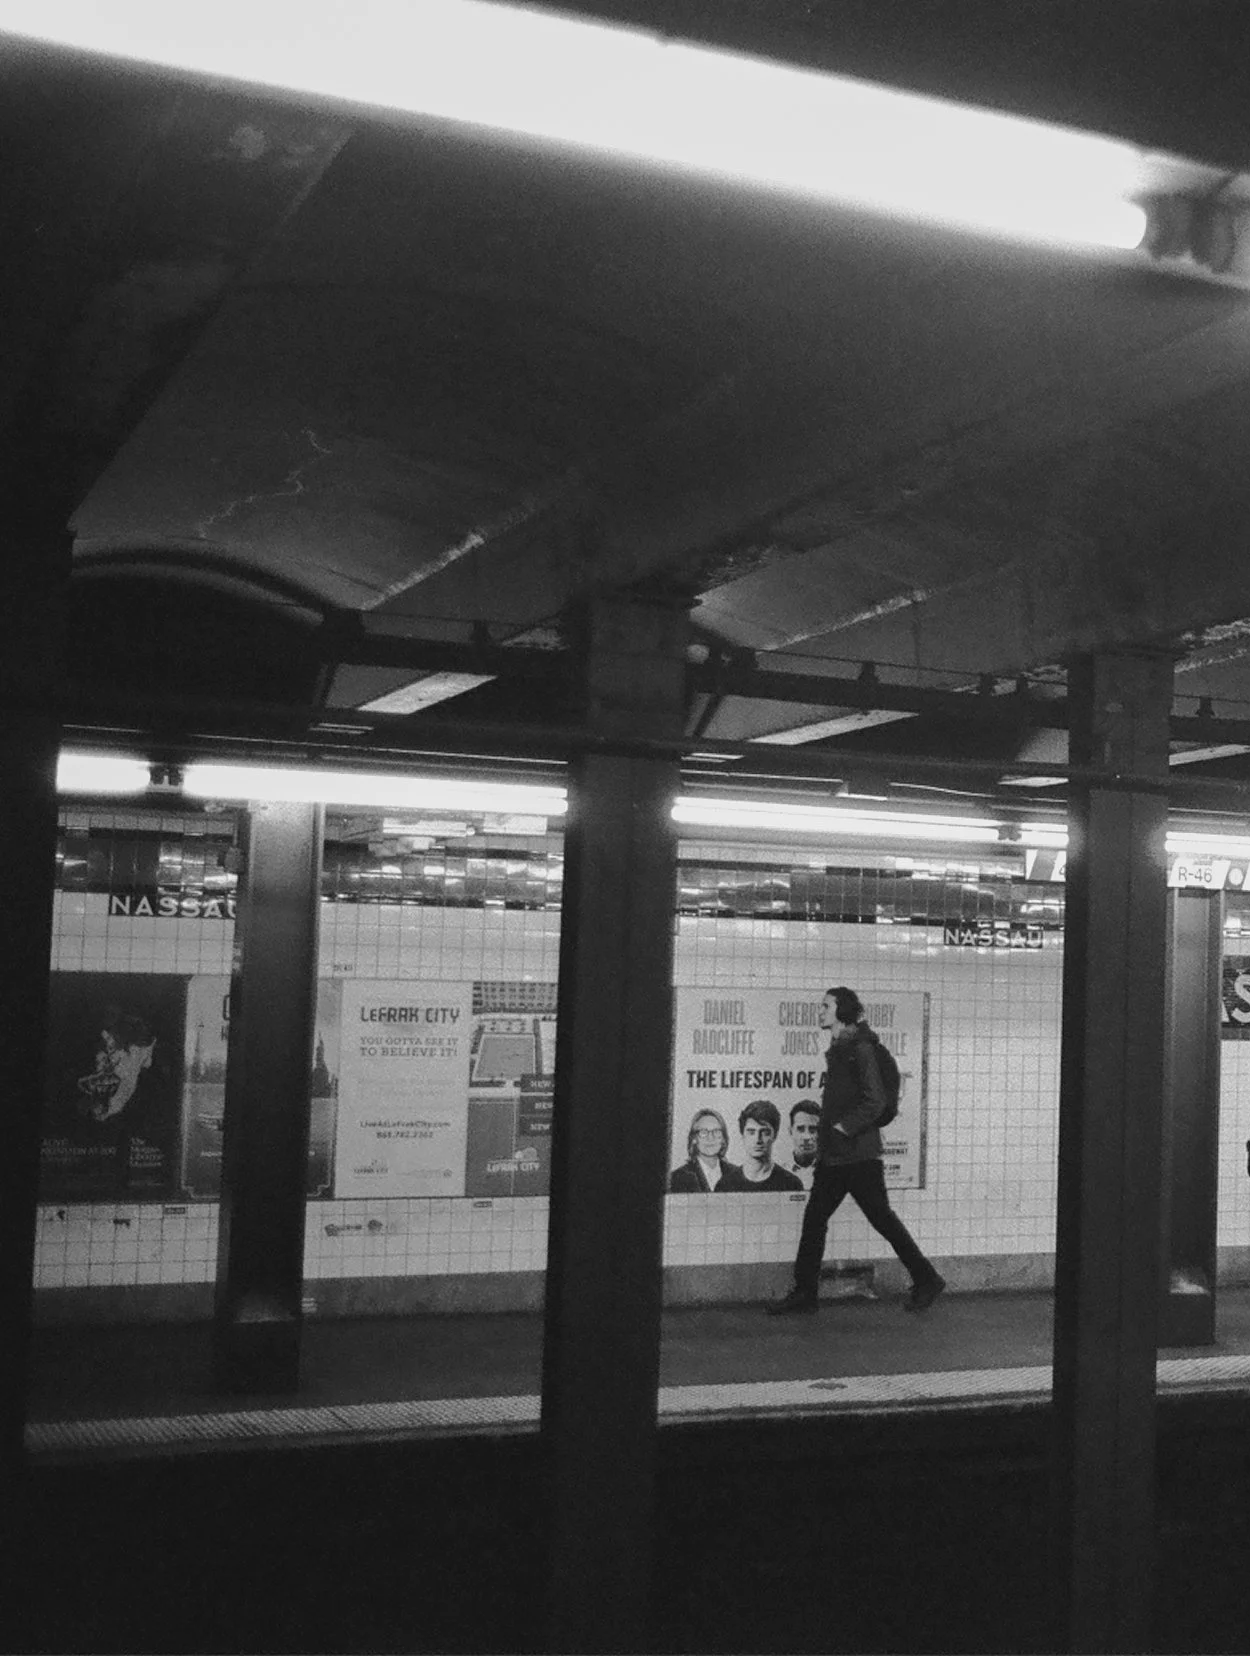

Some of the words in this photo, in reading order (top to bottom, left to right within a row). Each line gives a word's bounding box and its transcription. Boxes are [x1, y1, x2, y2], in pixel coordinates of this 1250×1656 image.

[1178, 866, 1213, 883] R-46
[945, 928, 1042, 947] NASSAU
[425, 1008, 460, 1024] CITY
[704, 999, 746, 1025] DANIEL
[865, 1003, 896, 1028] OBBY
[360, 1036, 383, 1046] YOU
[385, 1036, 422, 1046] GOTTA
[447, 1037, 459, 1046] IT
[693, 1029, 755, 1055] RADCLIFFE
[781, 1031, 819, 1056] JONES
[360, 1047, 377, 1057] TO
[381, 1047, 436, 1057] BELIEVE
[687, 1070, 717, 1089] THE
[720, 1070, 793, 1089] LIFESPAN
[796, 1071, 816, 1089] OF
